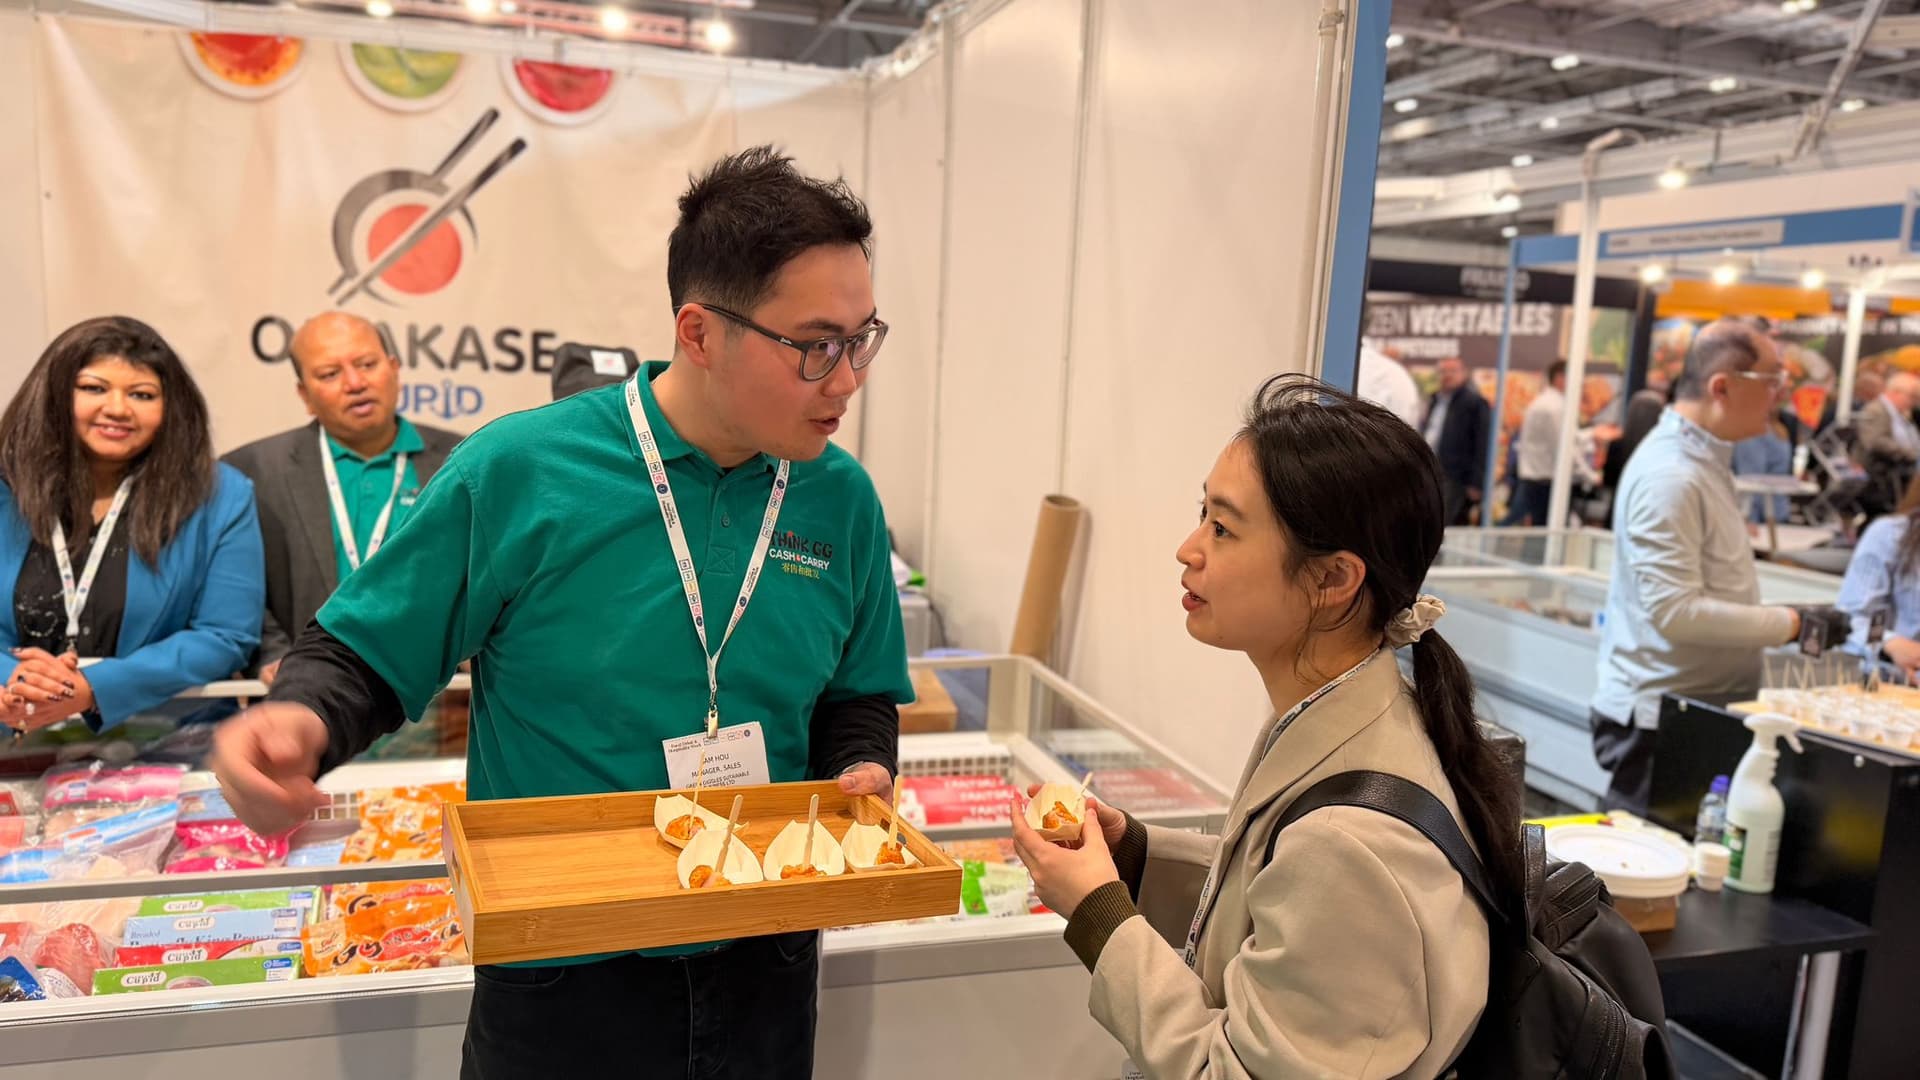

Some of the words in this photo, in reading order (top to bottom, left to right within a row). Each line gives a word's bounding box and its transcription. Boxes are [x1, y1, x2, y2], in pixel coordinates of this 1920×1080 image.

[1409, 303, 1553, 336] VEGETALES
[250, 315, 556, 373] OAKASE
[715, 753, 729, 762] HOU
[691, 767, 722, 778] MNAGER,
[723, 762, 742, 771] SALES
[178, 917, 210, 929] Cupid
[167, 950, 203, 963] Cupid
[126, 971, 161, 985] Cupid
